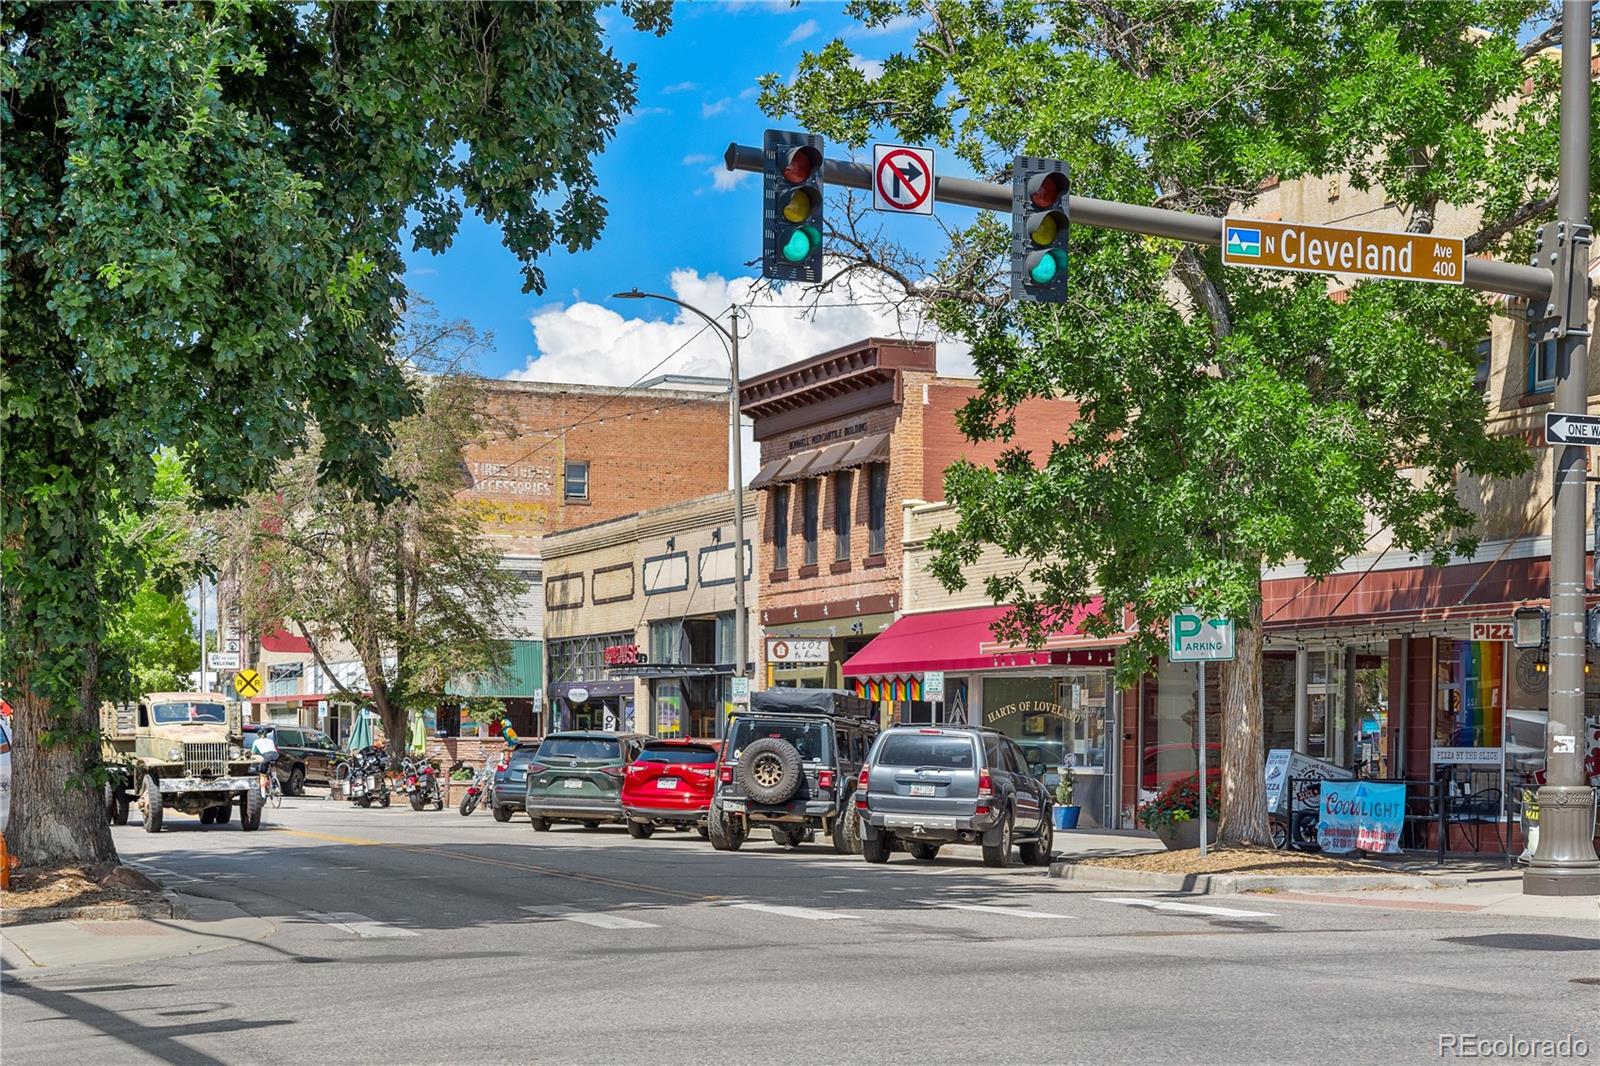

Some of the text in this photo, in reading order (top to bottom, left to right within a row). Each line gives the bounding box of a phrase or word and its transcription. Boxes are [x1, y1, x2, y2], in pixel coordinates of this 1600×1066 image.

[1265, 229, 1453, 273] N Cleveland Ave
[1432, 261, 1456, 277] 400
[1568, 424, 1588, 436] ONE
[987, 700, 1081, 723] HARTS OF LOVELAND
[1437, 752, 1498, 760] PIZZA BY THE SLICE
[1326, 792, 1361, 816] Coors
[1361, 803, 1400, 818] LIGHT
